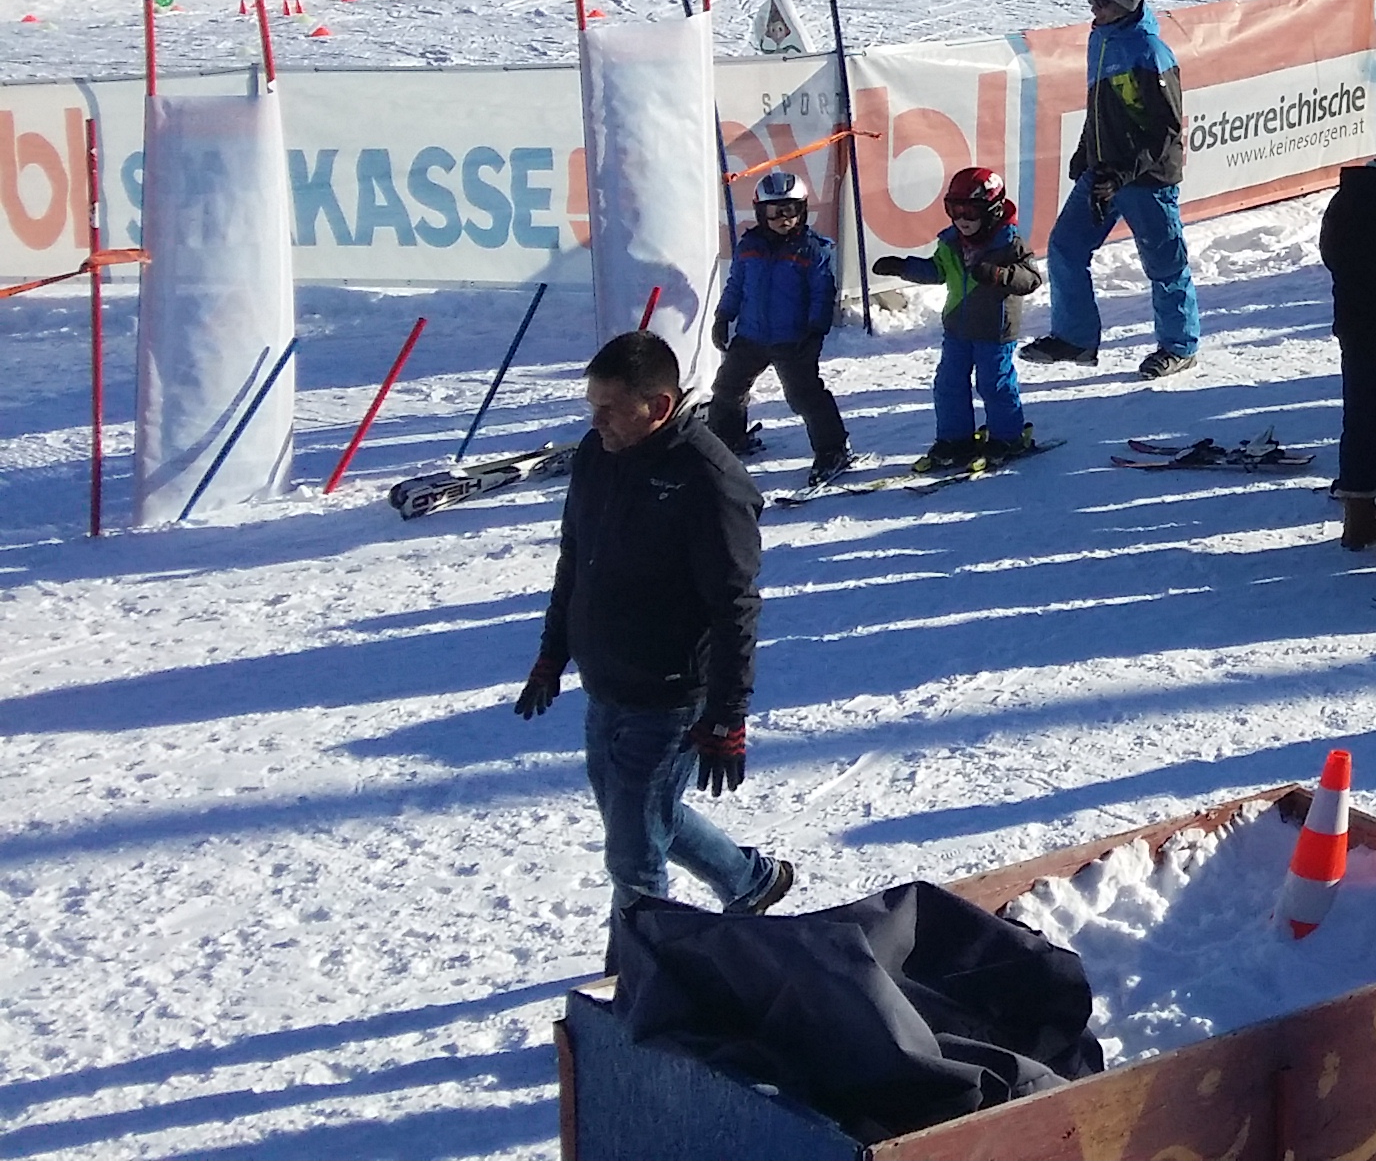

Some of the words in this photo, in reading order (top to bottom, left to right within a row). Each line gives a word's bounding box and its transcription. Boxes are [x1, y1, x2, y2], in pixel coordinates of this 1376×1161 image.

[1189, 82, 1366, 153] österreichische
[1226, 117, 1365, 168] www.keinesorgen.at
[412, 478, 482, 510] HEAD
